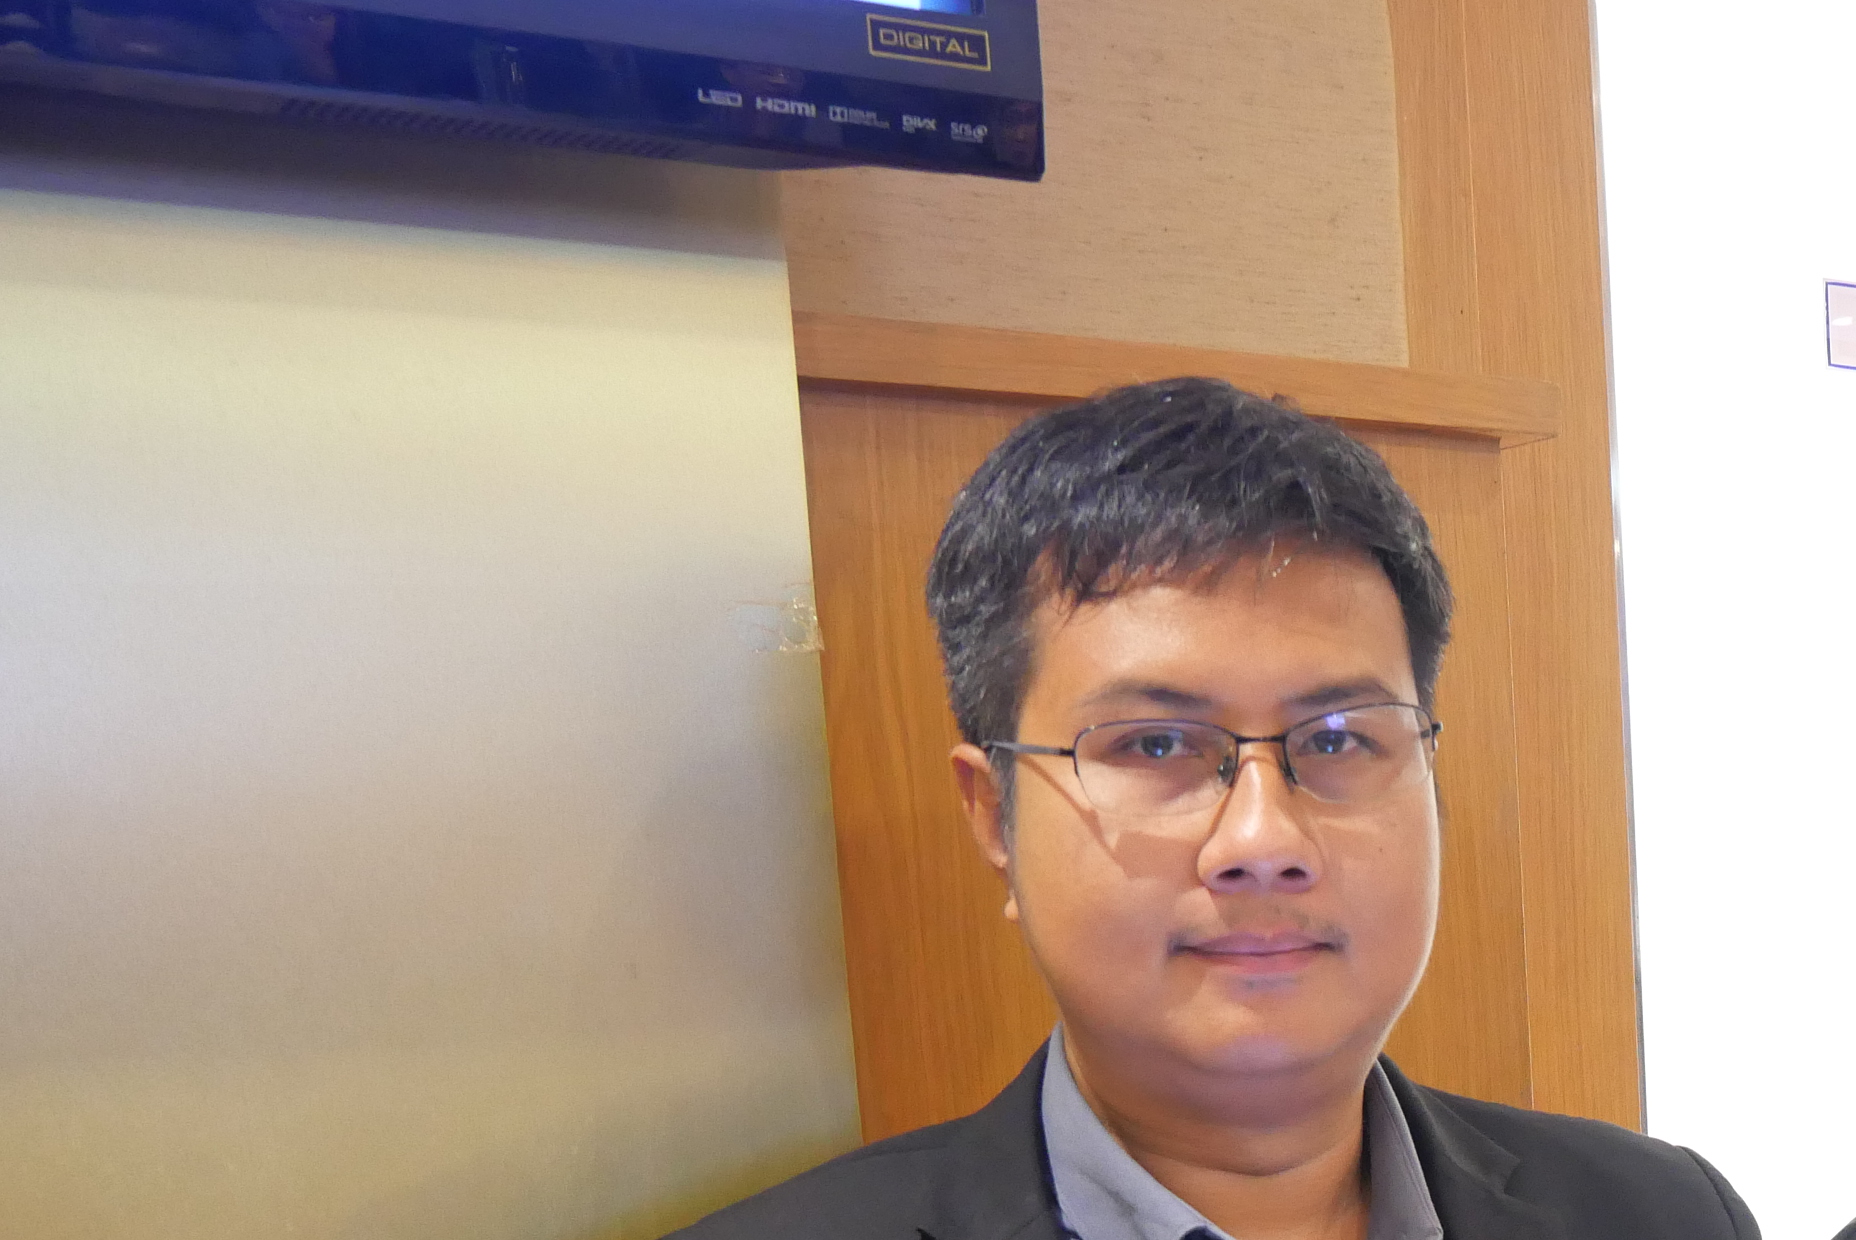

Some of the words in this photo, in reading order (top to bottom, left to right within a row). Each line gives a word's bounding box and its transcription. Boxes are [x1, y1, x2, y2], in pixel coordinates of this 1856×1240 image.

[879, 28, 979, 58] DIGITAL
[698, 88, 742, 107] LED
[756, 97, 816, 118] HDMI
